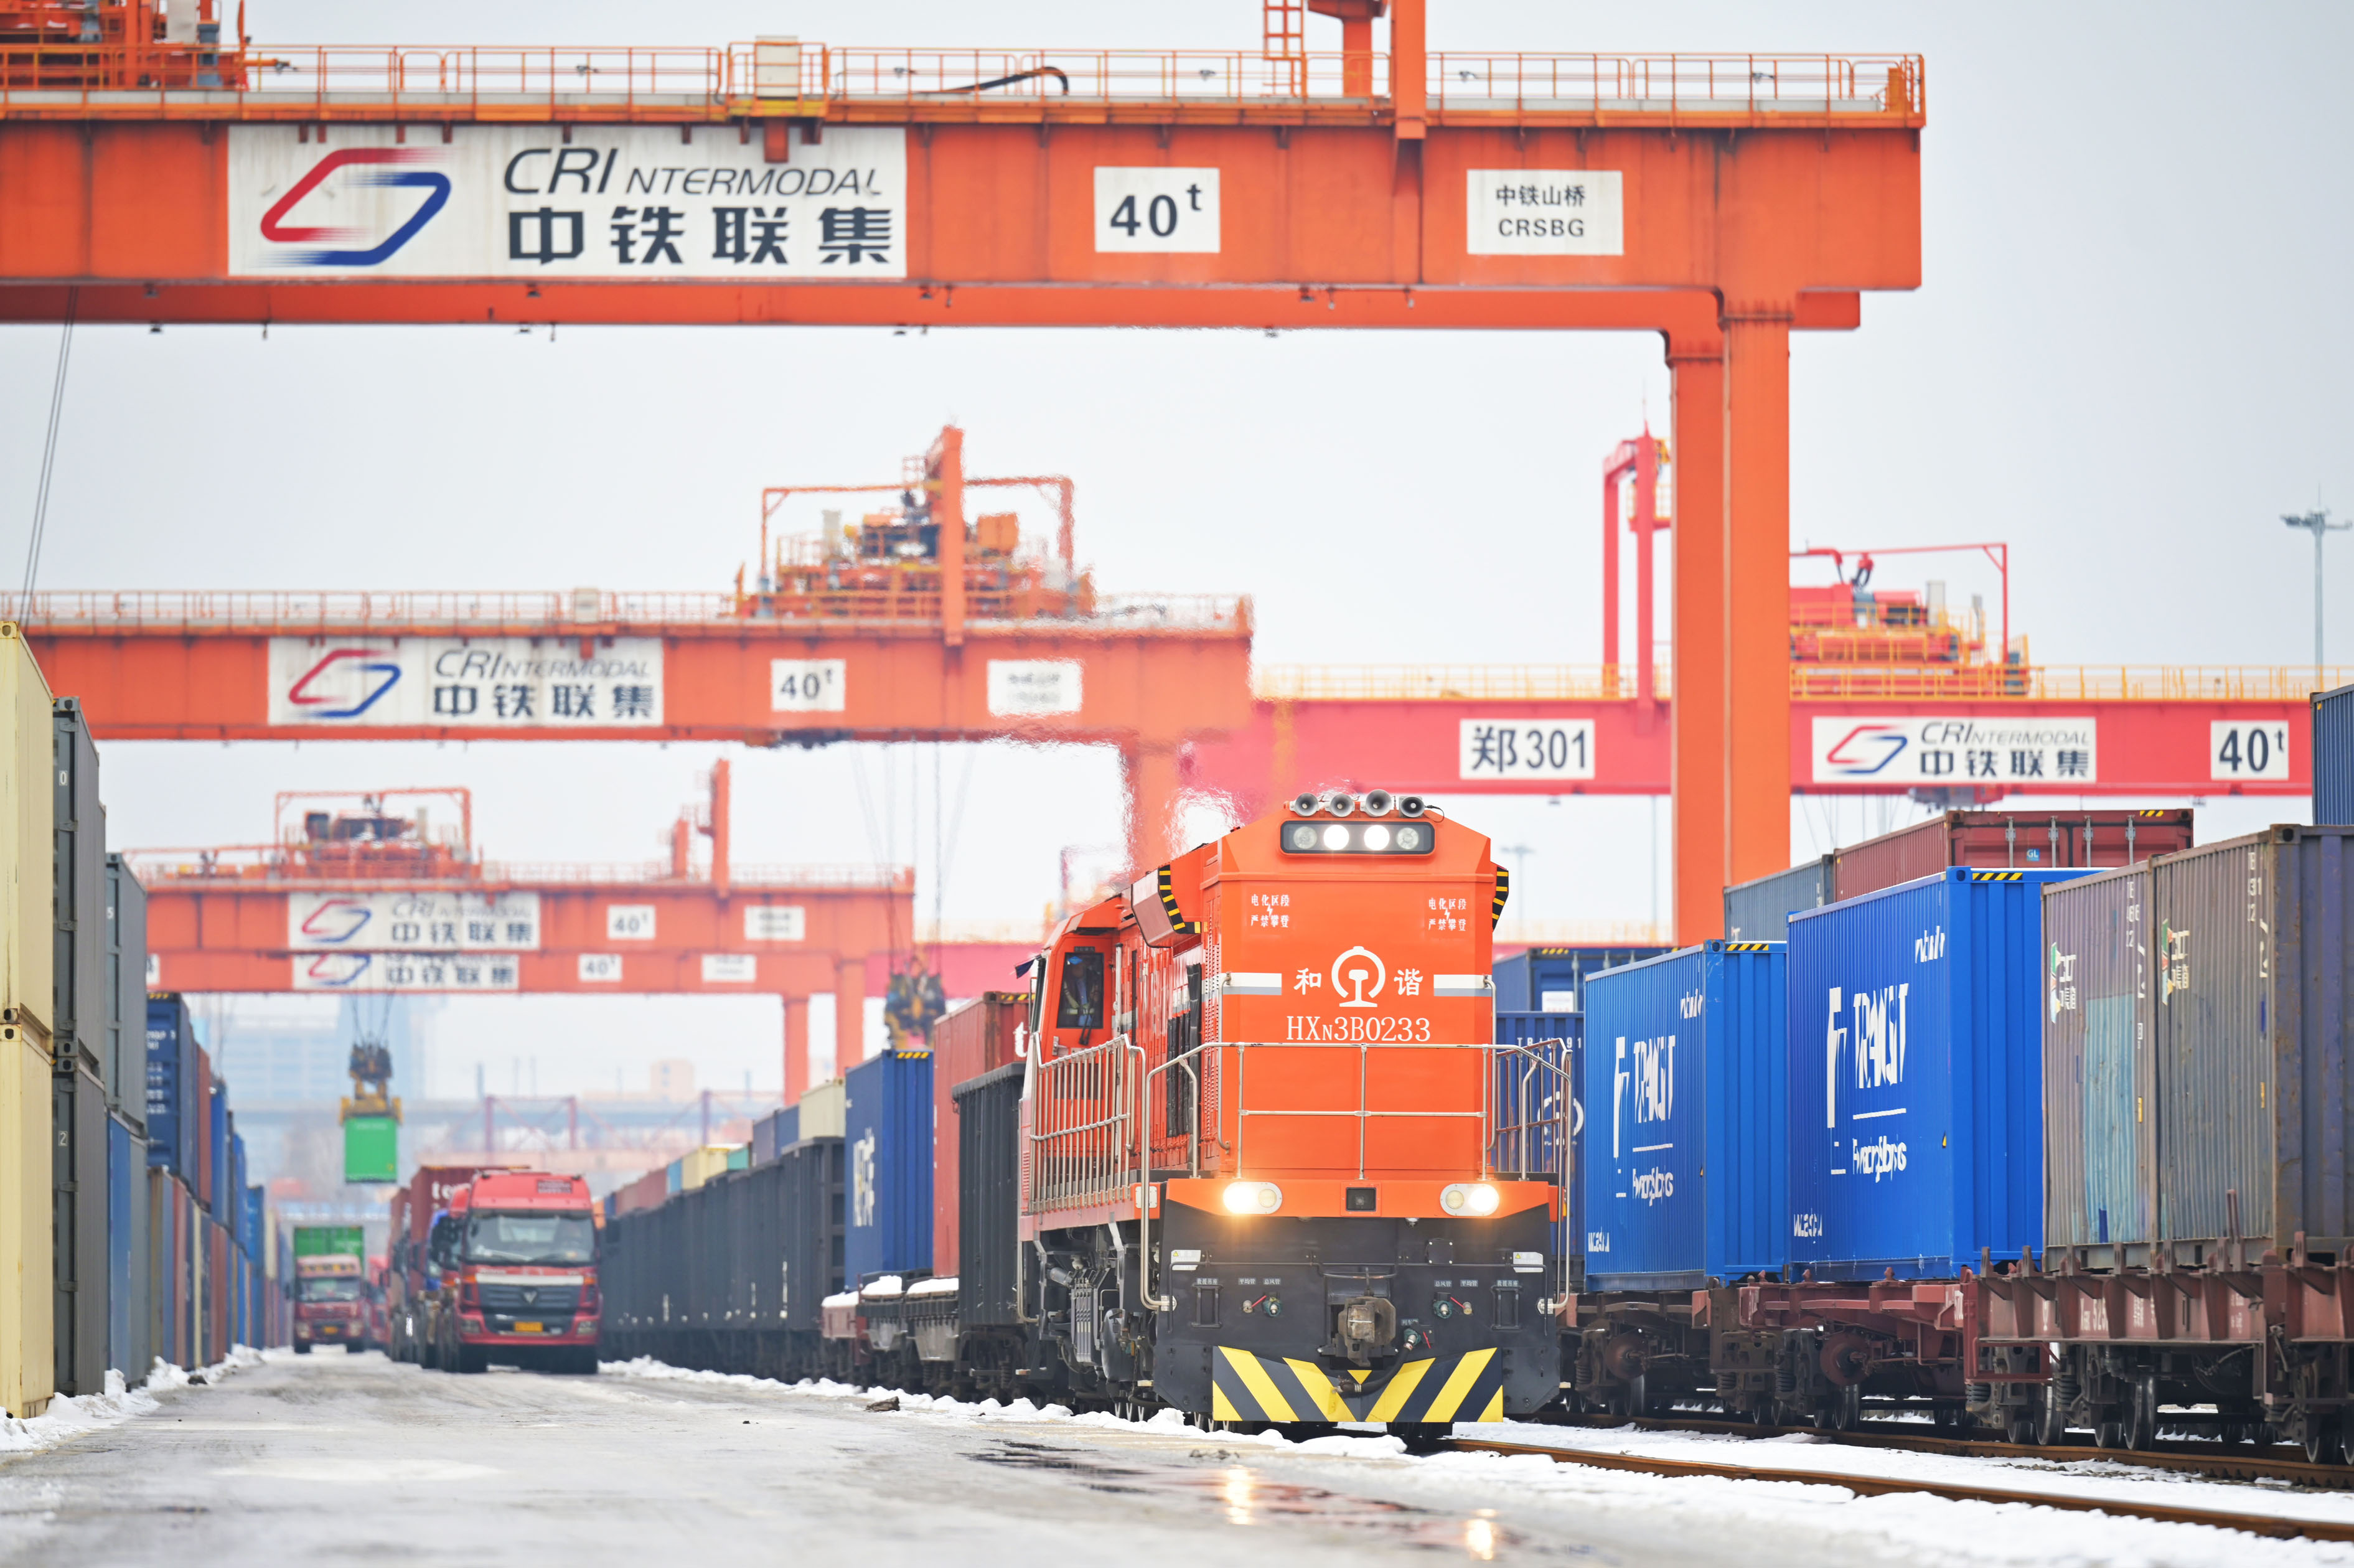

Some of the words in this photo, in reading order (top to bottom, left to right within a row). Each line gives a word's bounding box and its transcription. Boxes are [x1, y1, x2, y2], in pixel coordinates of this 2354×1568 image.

[1495, 185, 1587, 207] 中铁山桥
[1110, 184, 1203, 237] 40t
[509, 206, 892, 265] 中铁联集
[1498, 218, 1585, 237] CRSBG
[433, 683, 654, 718] 中铁联集
[1472, 726, 1586, 772] 郑301
[2219, 728, 2286, 772] 40t
[1920, 749, 2089, 777] 中铁联集
[1251, 893, 1290, 906] 电化区段
[1428, 898, 1466, 910] 电化区段
[1250, 914, 1290, 928] 严禁攀登
[1428, 918, 1466, 931] 严禁攀登
[1294, 967, 1321, 995] 和
[1394, 968, 1423, 996] 谐
[1286, 1016, 1431, 1042] HXN3B0233
